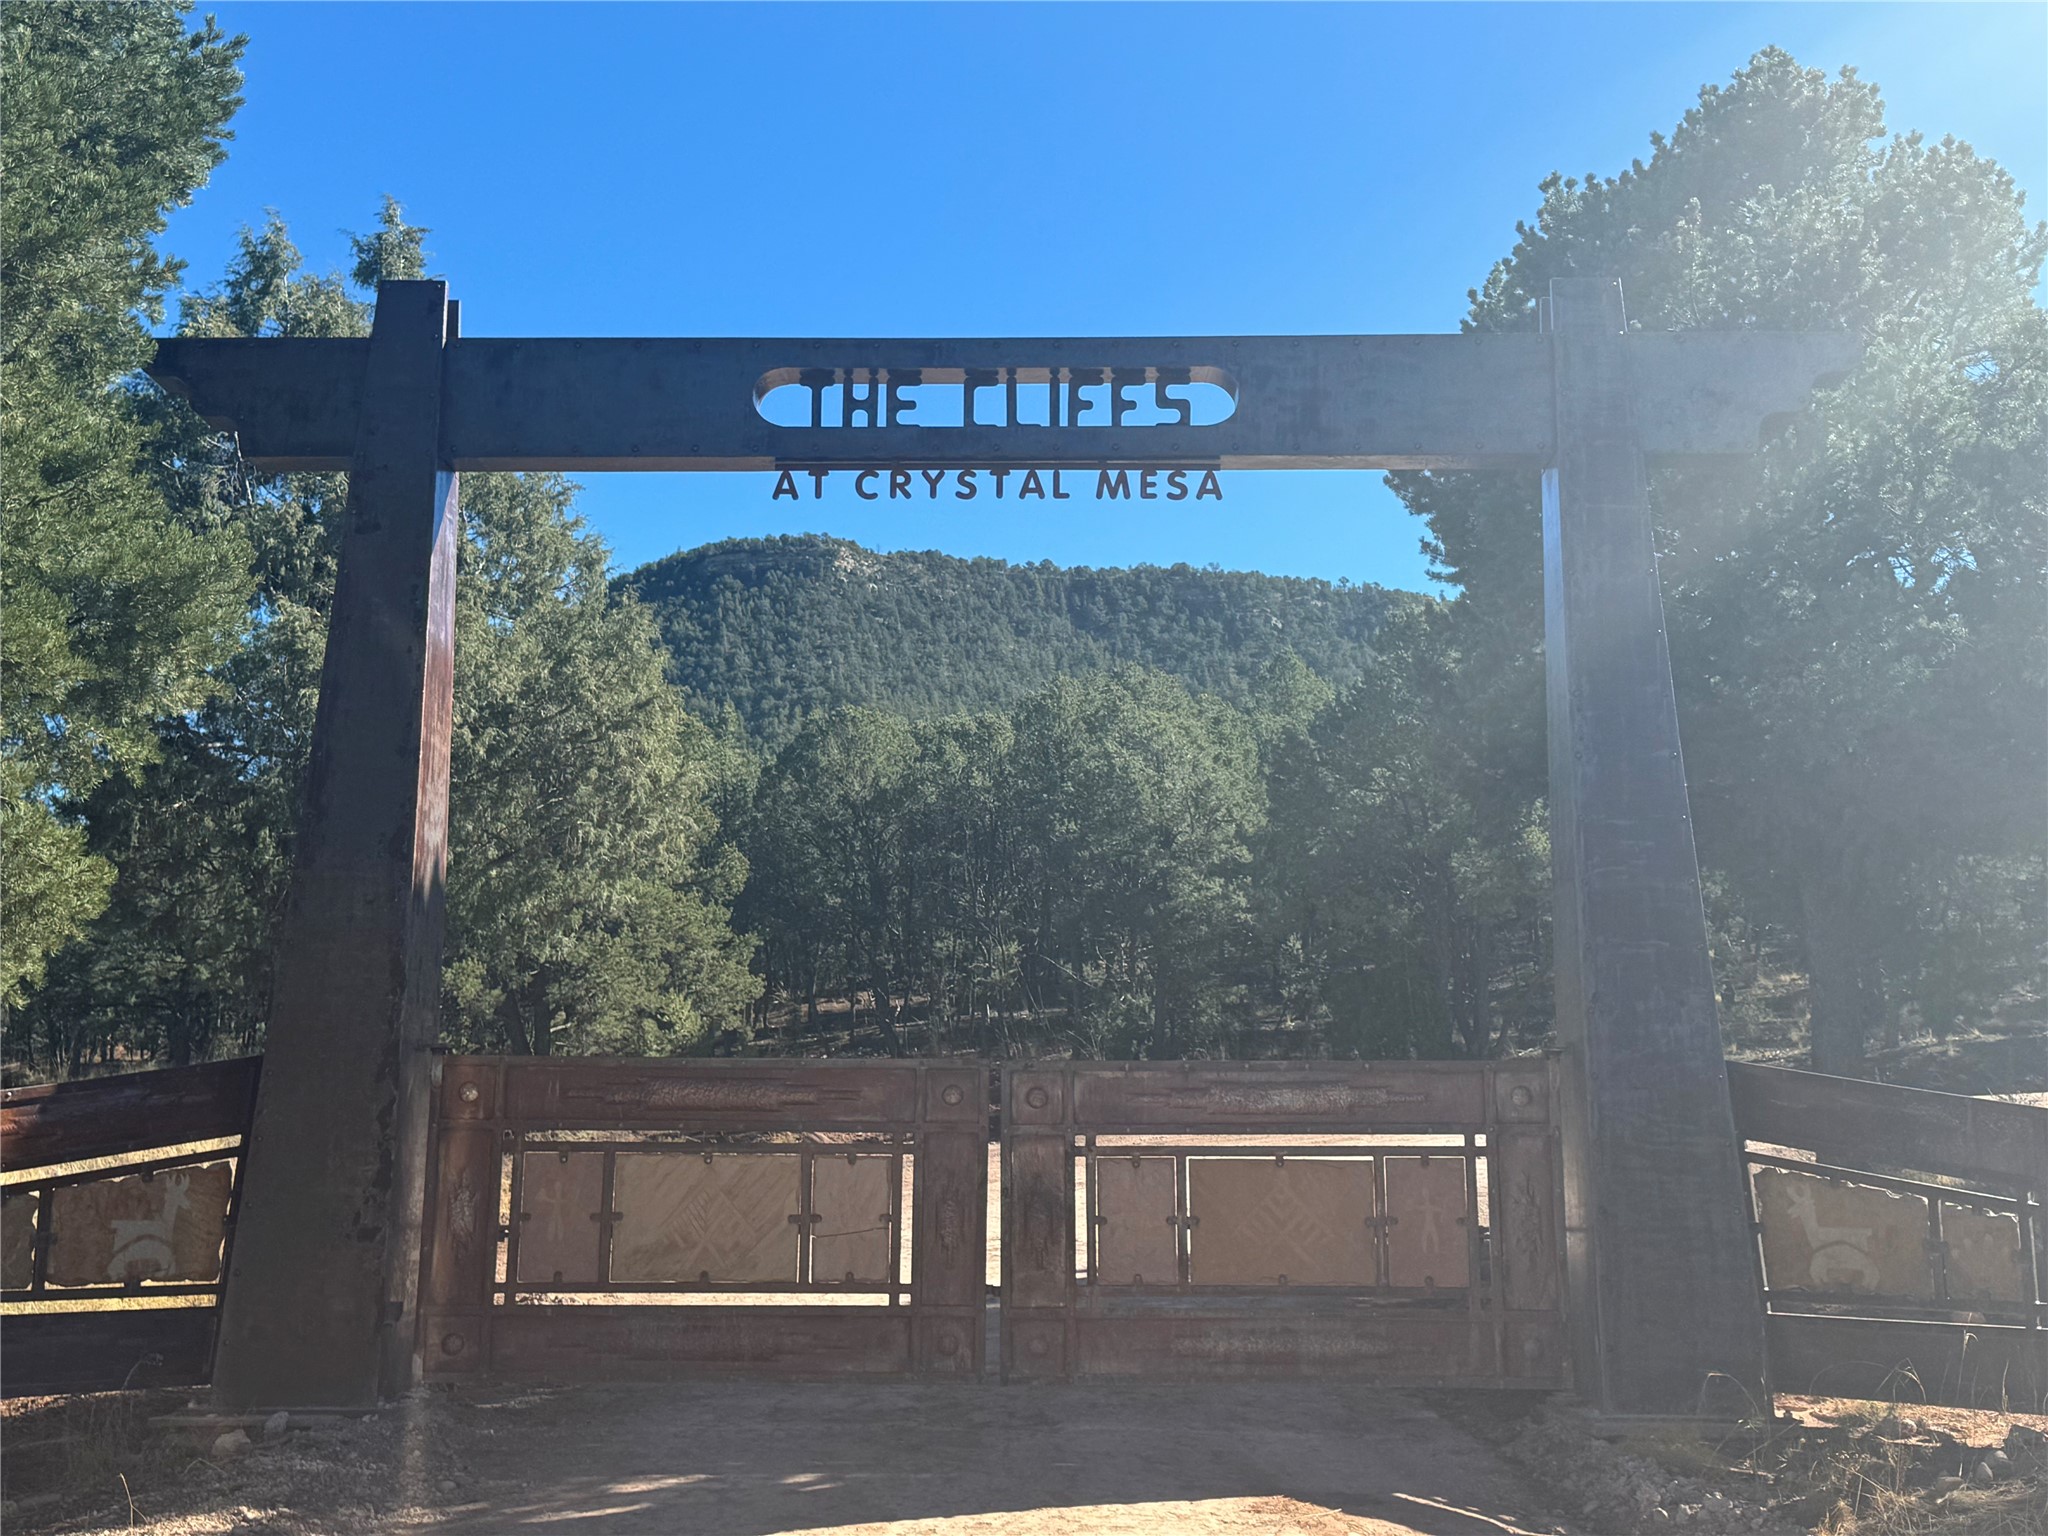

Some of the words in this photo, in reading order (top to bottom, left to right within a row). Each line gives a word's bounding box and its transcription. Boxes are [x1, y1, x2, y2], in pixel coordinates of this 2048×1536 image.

[800, 372, 922, 428] THE
[963, 372, 1191, 428] CLIFFS
[772, 467, 830, 500] AT
[855, 467, 1070, 500] CRYSTAL
[1096, 467, 1222, 500] MESA
